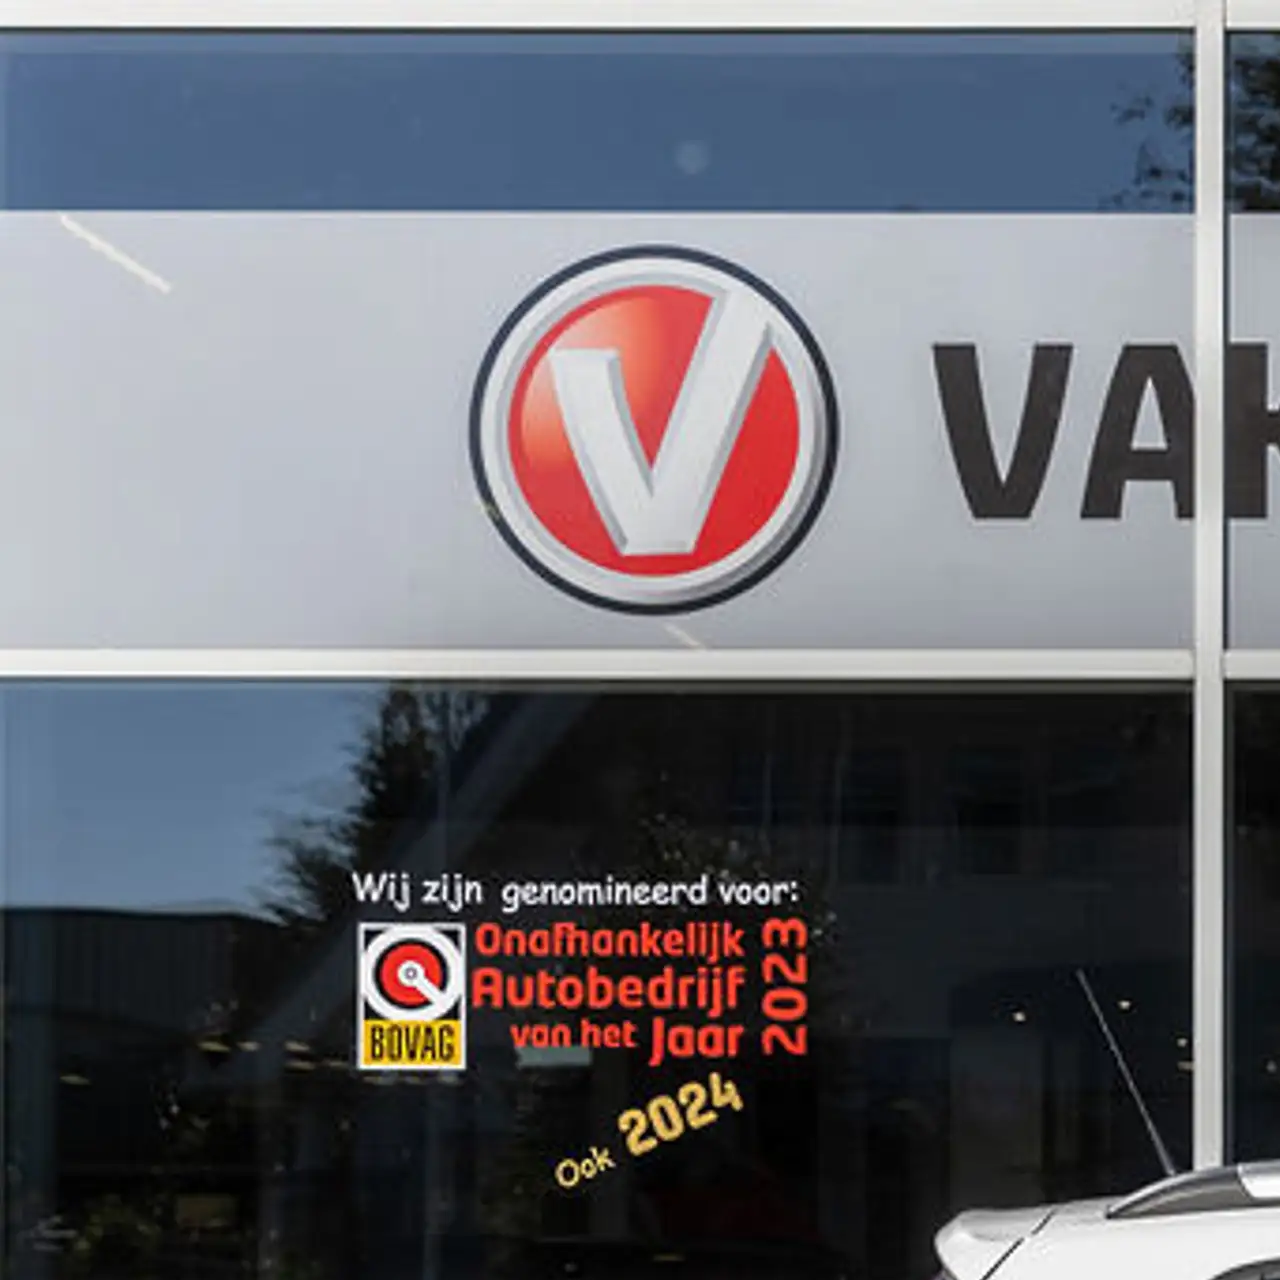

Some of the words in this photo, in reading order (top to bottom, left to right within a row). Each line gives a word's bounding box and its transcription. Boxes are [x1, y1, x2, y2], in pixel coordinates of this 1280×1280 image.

[548, 290, 774, 556] V
[352, 872, 410, 912] Wij
[421, 873, 482, 912] zijn
[502, 874, 708, 912] genomineerd
[719, 880, 799, 905] voor:
[474, 922, 745, 963] Onafhankelijk
[472, 967, 746, 1018] Autobedrijf
[762, 918, 808, 1055] 2023
[370, 1024, 455, 1062] BOVAG
[510, 1023, 571, 1048] van
[580, 1019, 636, 1048] het
[648, 1016, 744, 1067] Jaar
[555, 1147, 616, 1187] Ook
[617, 1072, 744, 1157] 2024
